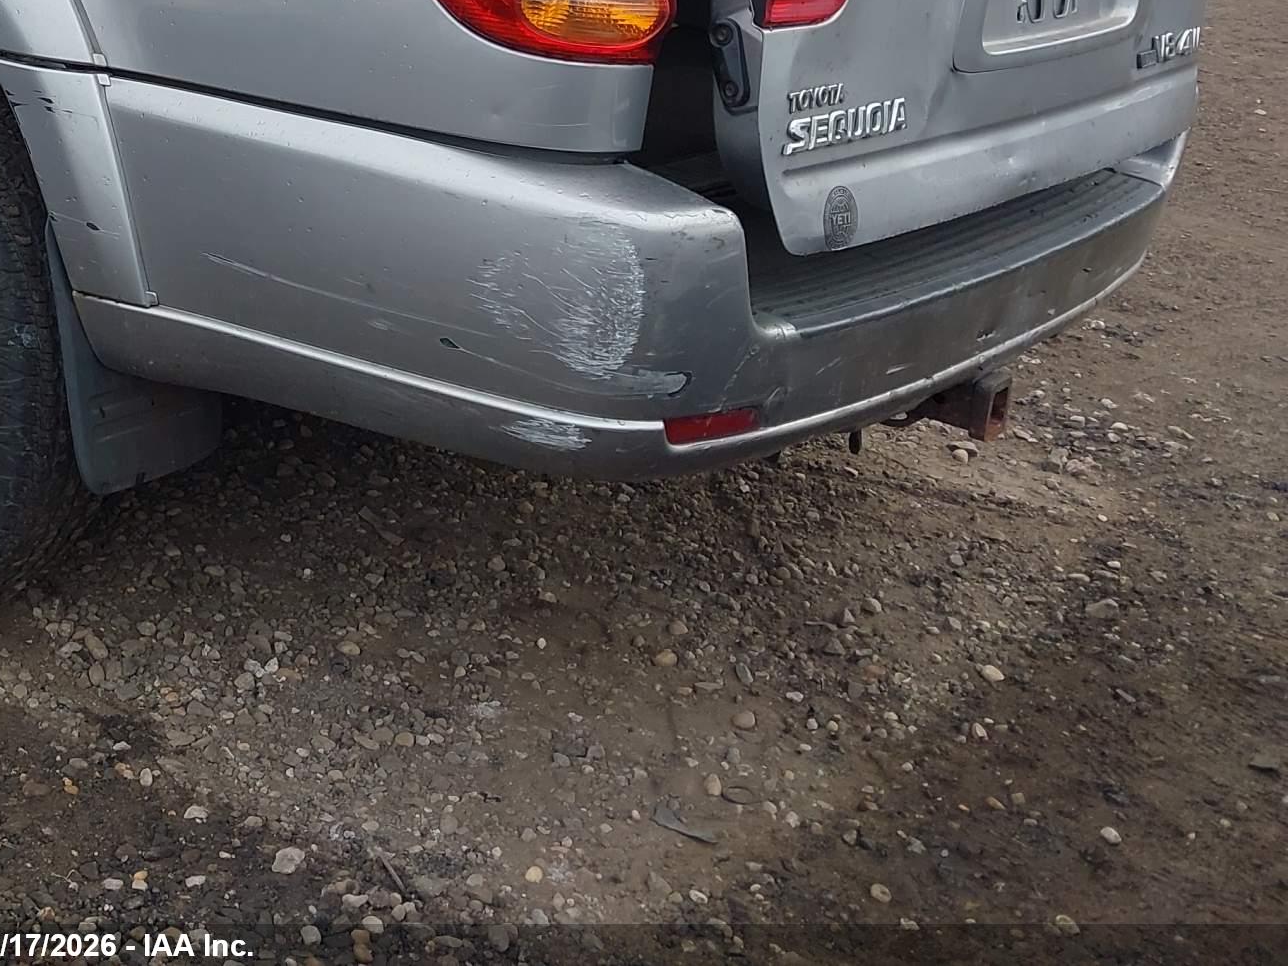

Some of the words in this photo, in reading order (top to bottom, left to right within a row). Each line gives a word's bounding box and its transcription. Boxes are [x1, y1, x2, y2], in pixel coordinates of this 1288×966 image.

[788, 82, 845, 114] TOYOTA
[781, 97, 907, 155] SEQUOIA
[830, 211, 852, 227] YETI
